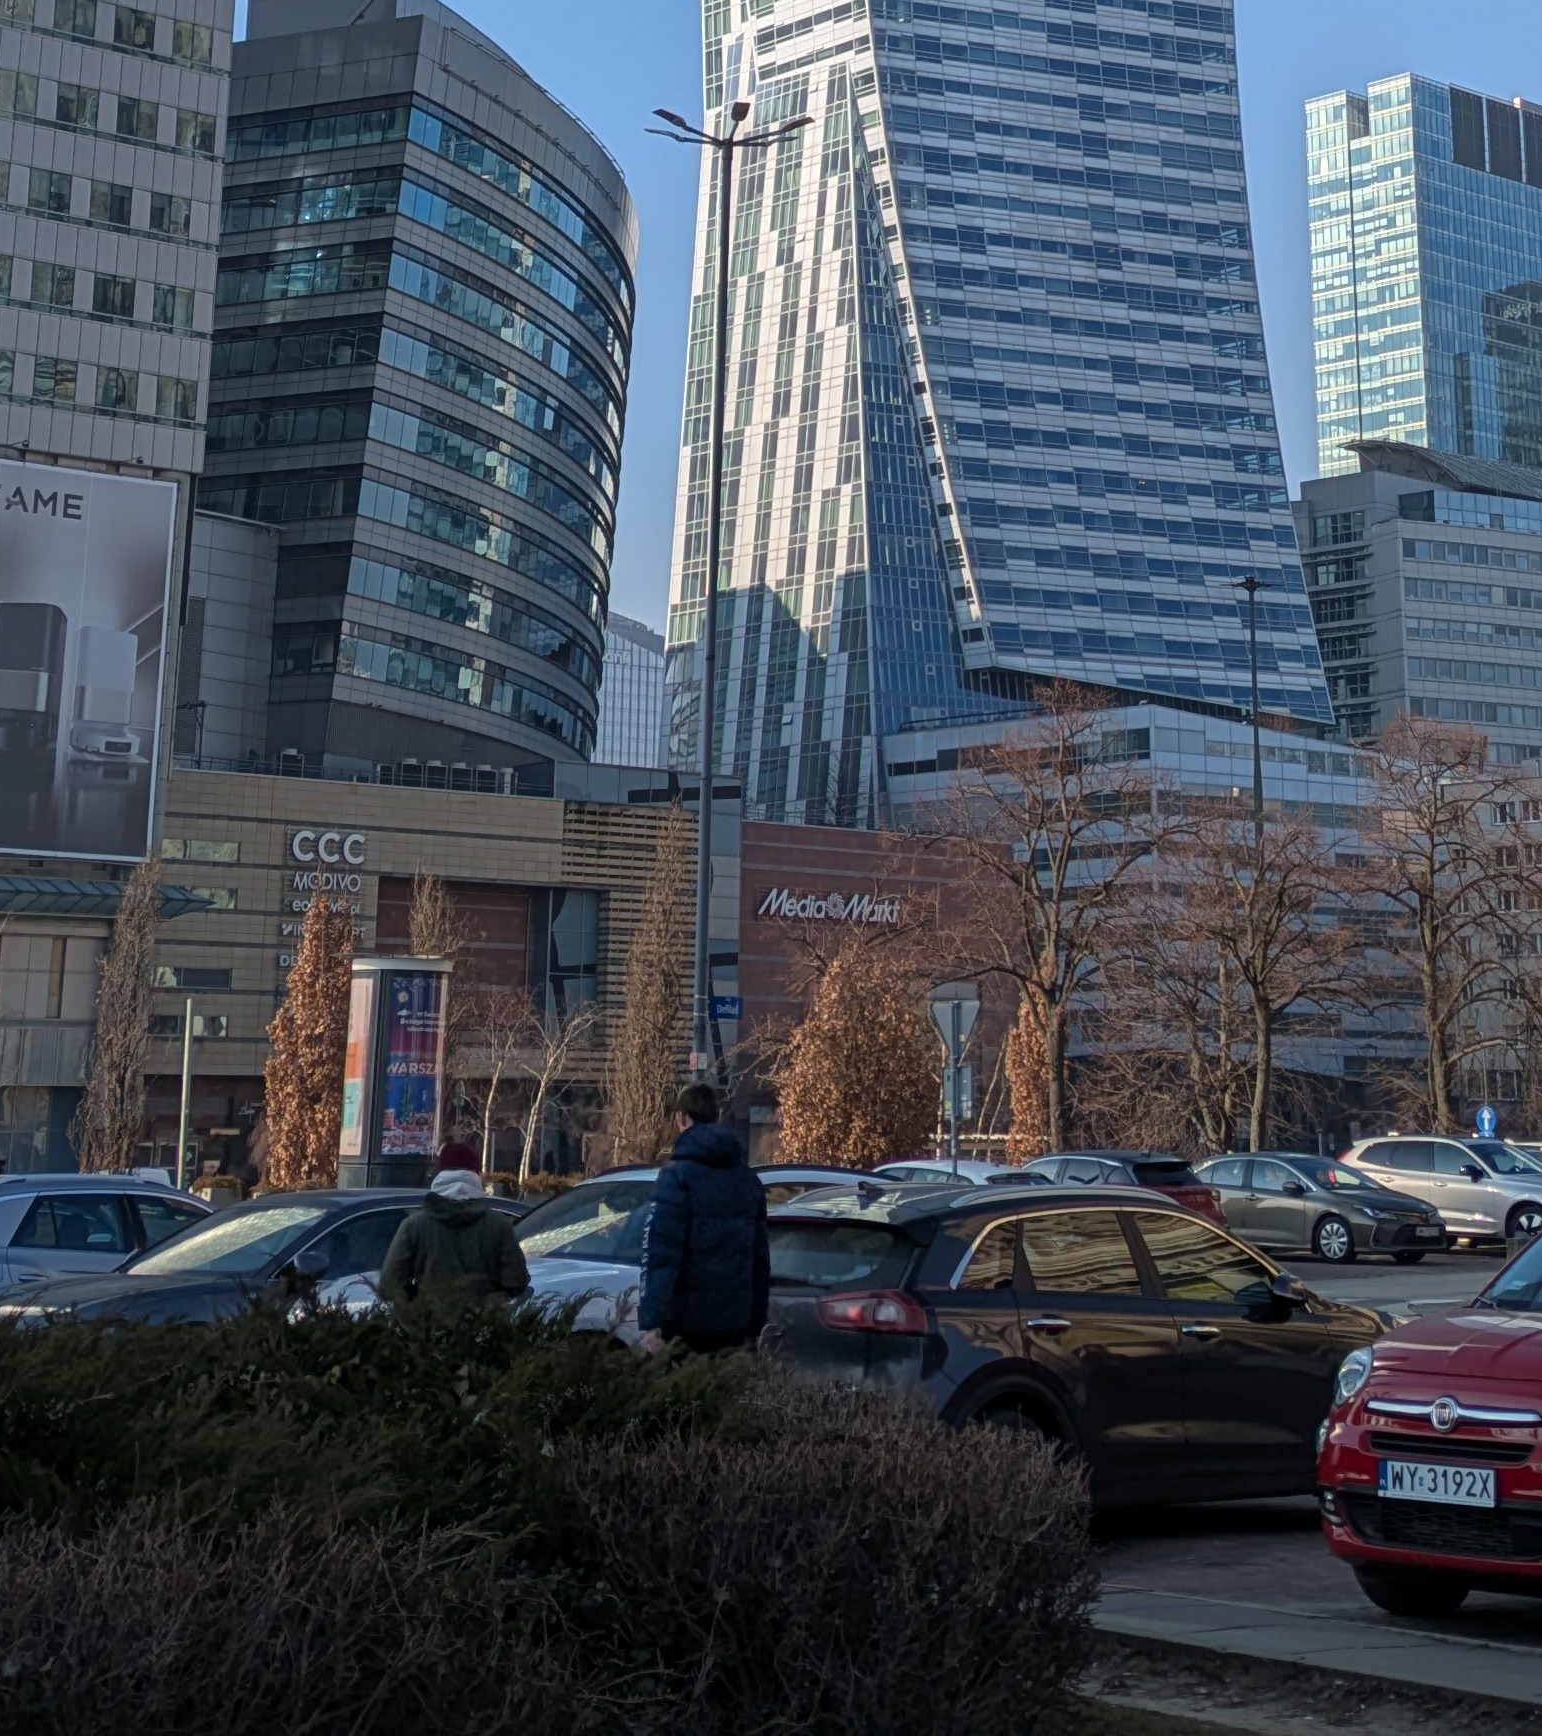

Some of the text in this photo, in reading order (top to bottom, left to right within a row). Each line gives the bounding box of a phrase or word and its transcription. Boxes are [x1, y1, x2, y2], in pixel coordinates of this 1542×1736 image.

[292, 830, 365, 864] CCC
[293, 871, 361, 892] MODIVO
[1391, 1464, 1419, 1491] WY
[1427, 1468, 1491, 1499] 3192X
